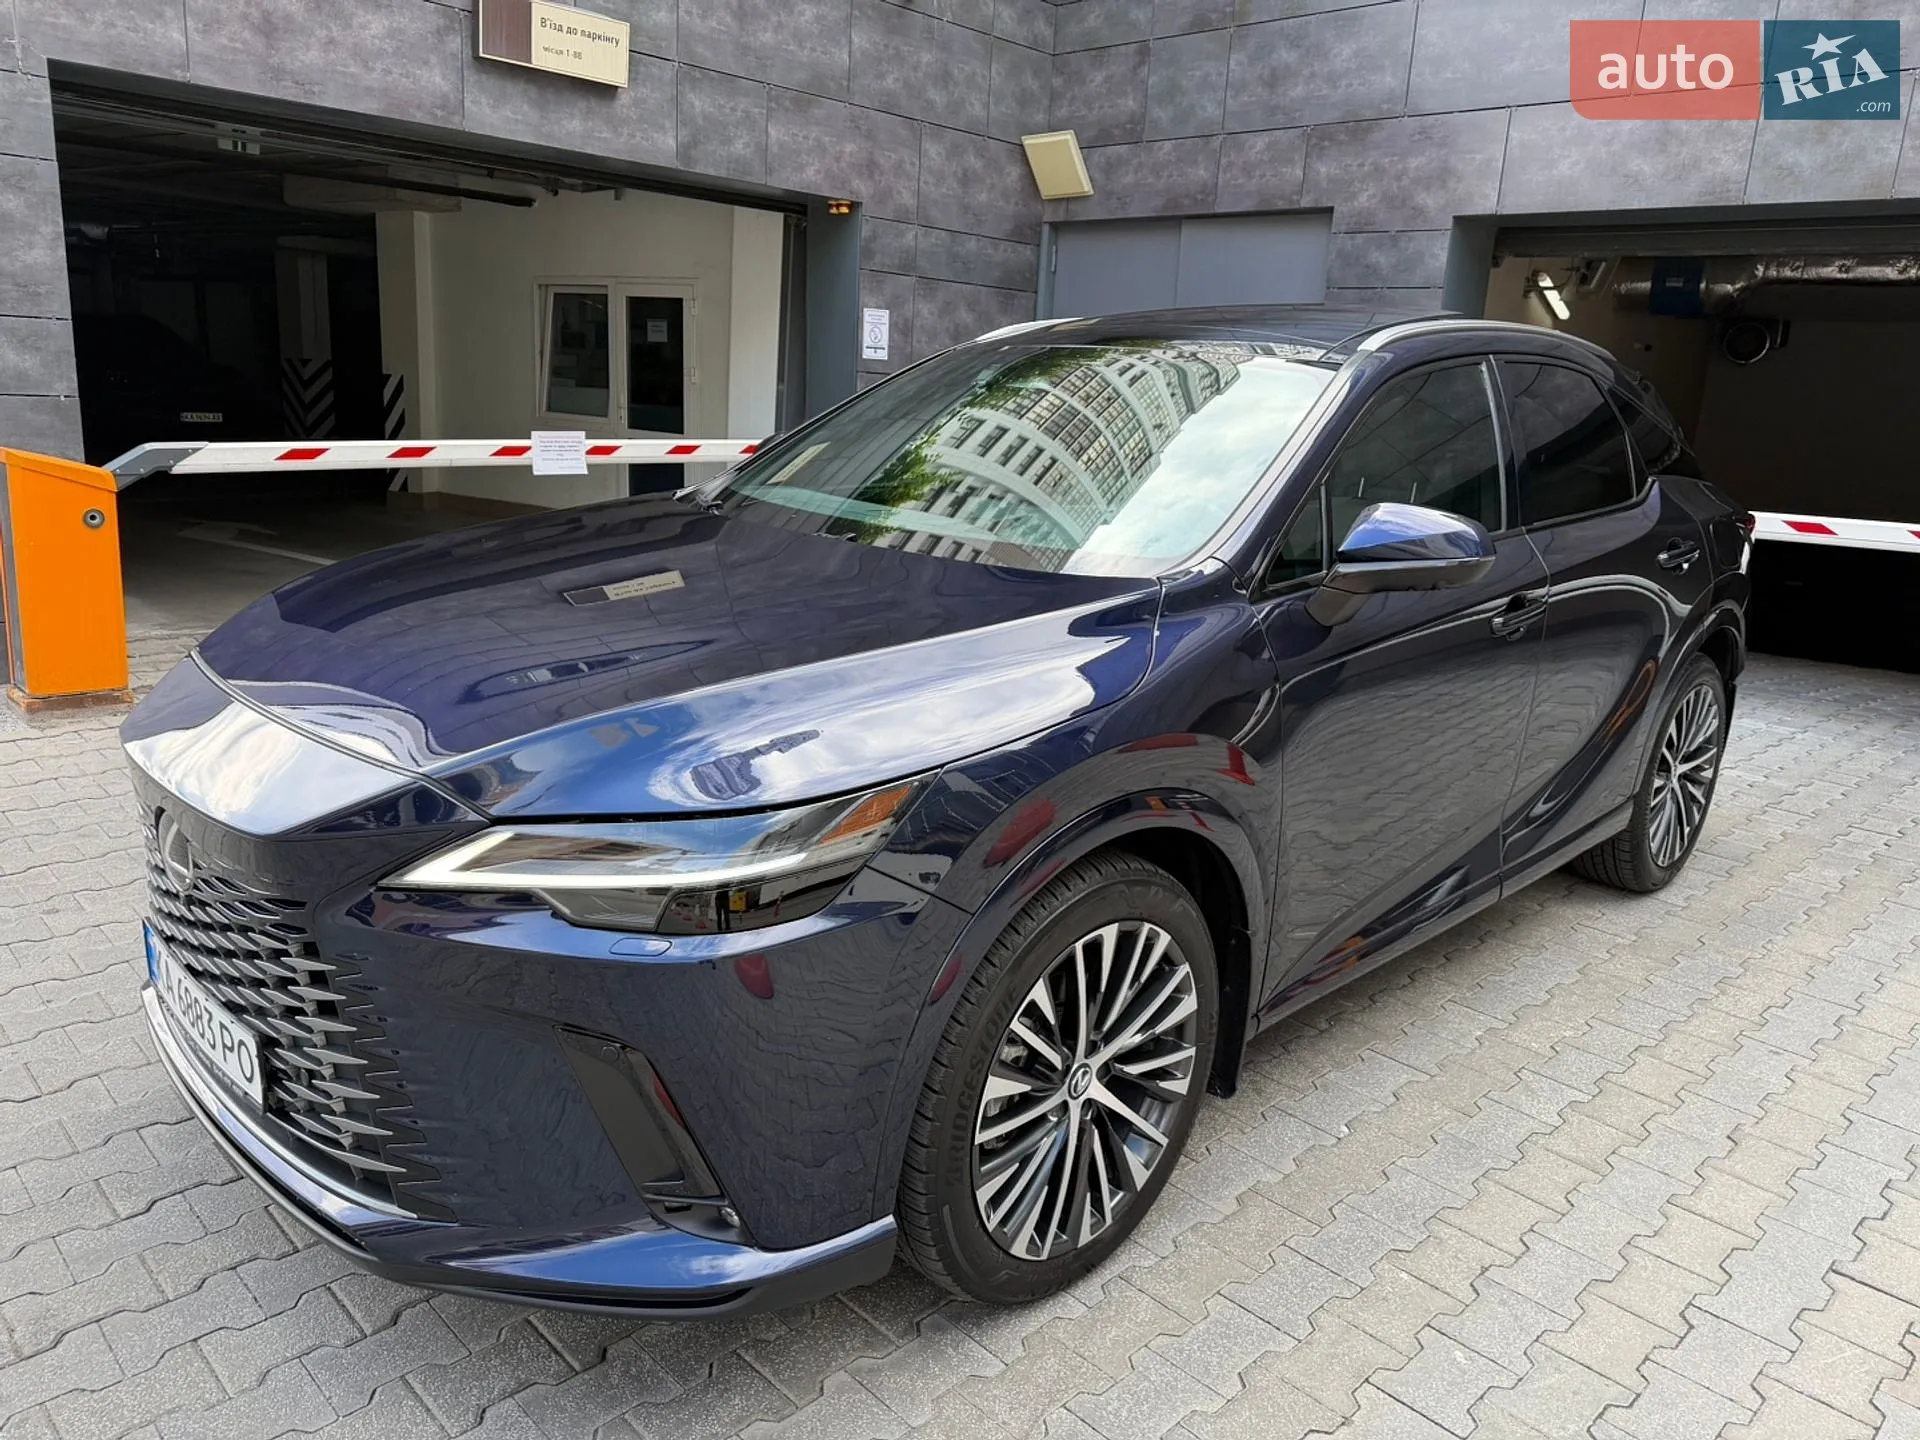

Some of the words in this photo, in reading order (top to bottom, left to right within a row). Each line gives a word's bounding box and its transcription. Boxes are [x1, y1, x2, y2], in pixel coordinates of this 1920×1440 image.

[566, 26, 577, 36] до
[580, 27, 620, 47] паркінгу
[177, 978, 216, 1050] 6883
[219, 1021, 254, 1084] PO
